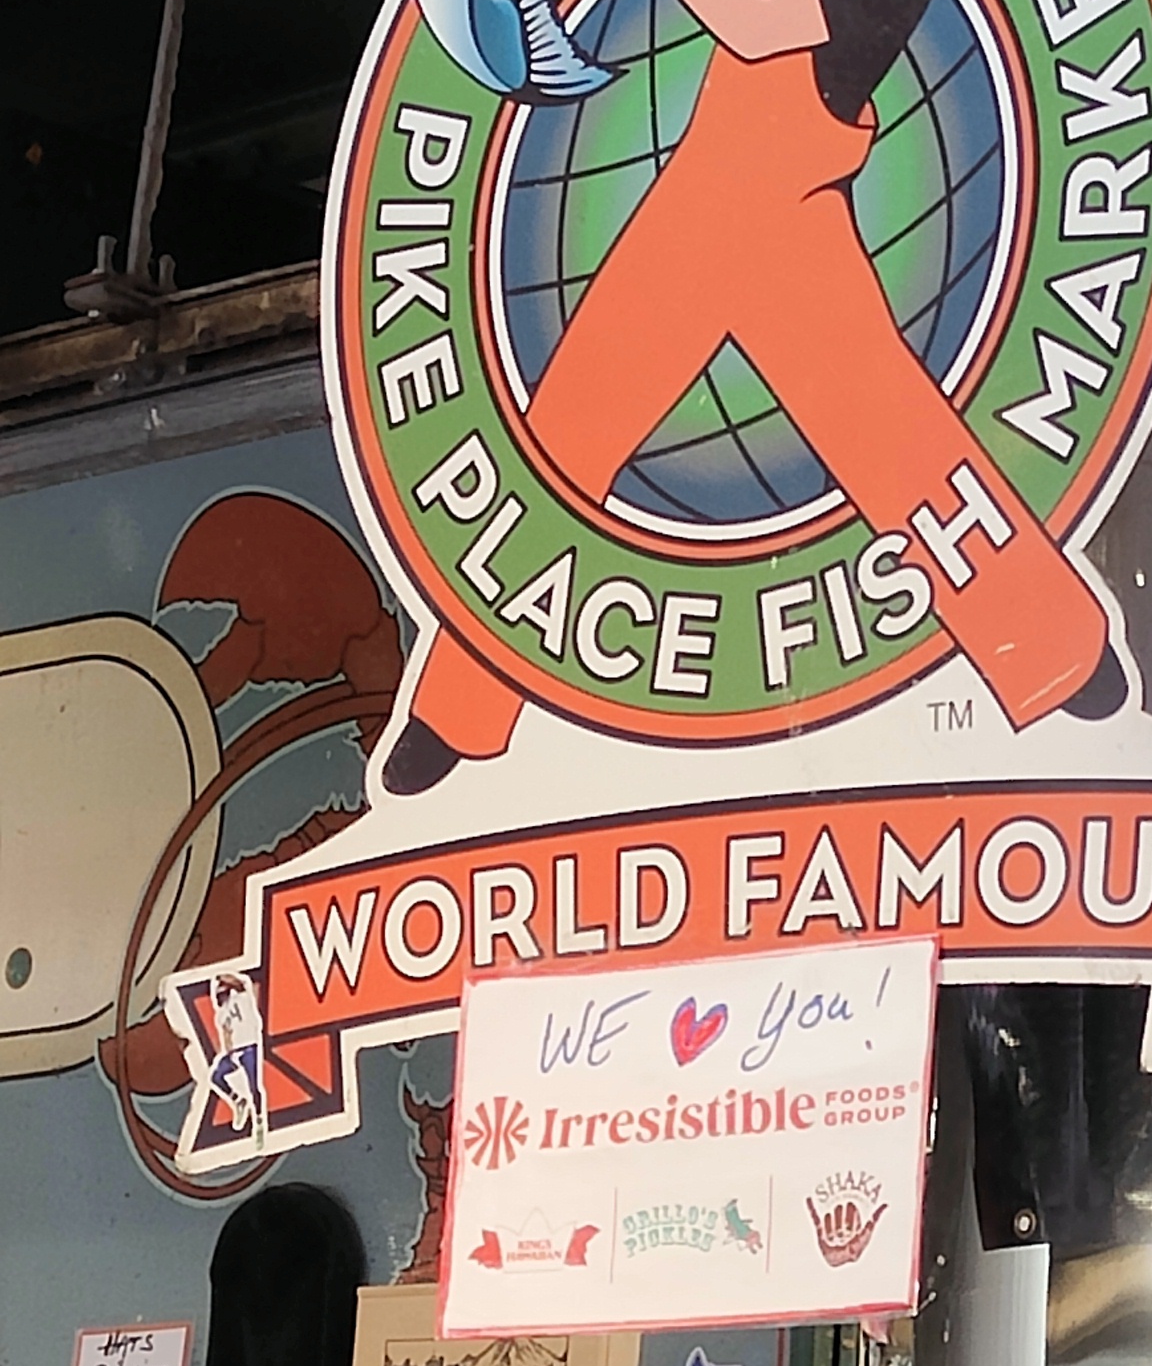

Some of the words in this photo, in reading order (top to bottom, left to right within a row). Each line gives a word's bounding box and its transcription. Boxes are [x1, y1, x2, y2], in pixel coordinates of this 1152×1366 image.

[374, 106, 470, 424] PIKE
[416, 436, 720, 695] PLACE
[757, 463, 1016, 688] FISH
[927, 701, 975, 733] TM
[284, 843, 687, 990] WORLD
[539, 990, 652, 1074] WE
[539, 1087, 815, 1149] Irresistible
[824, 1105, 907, 1126] GROUP
[814, 1170, 883, 1204] SHAKA
